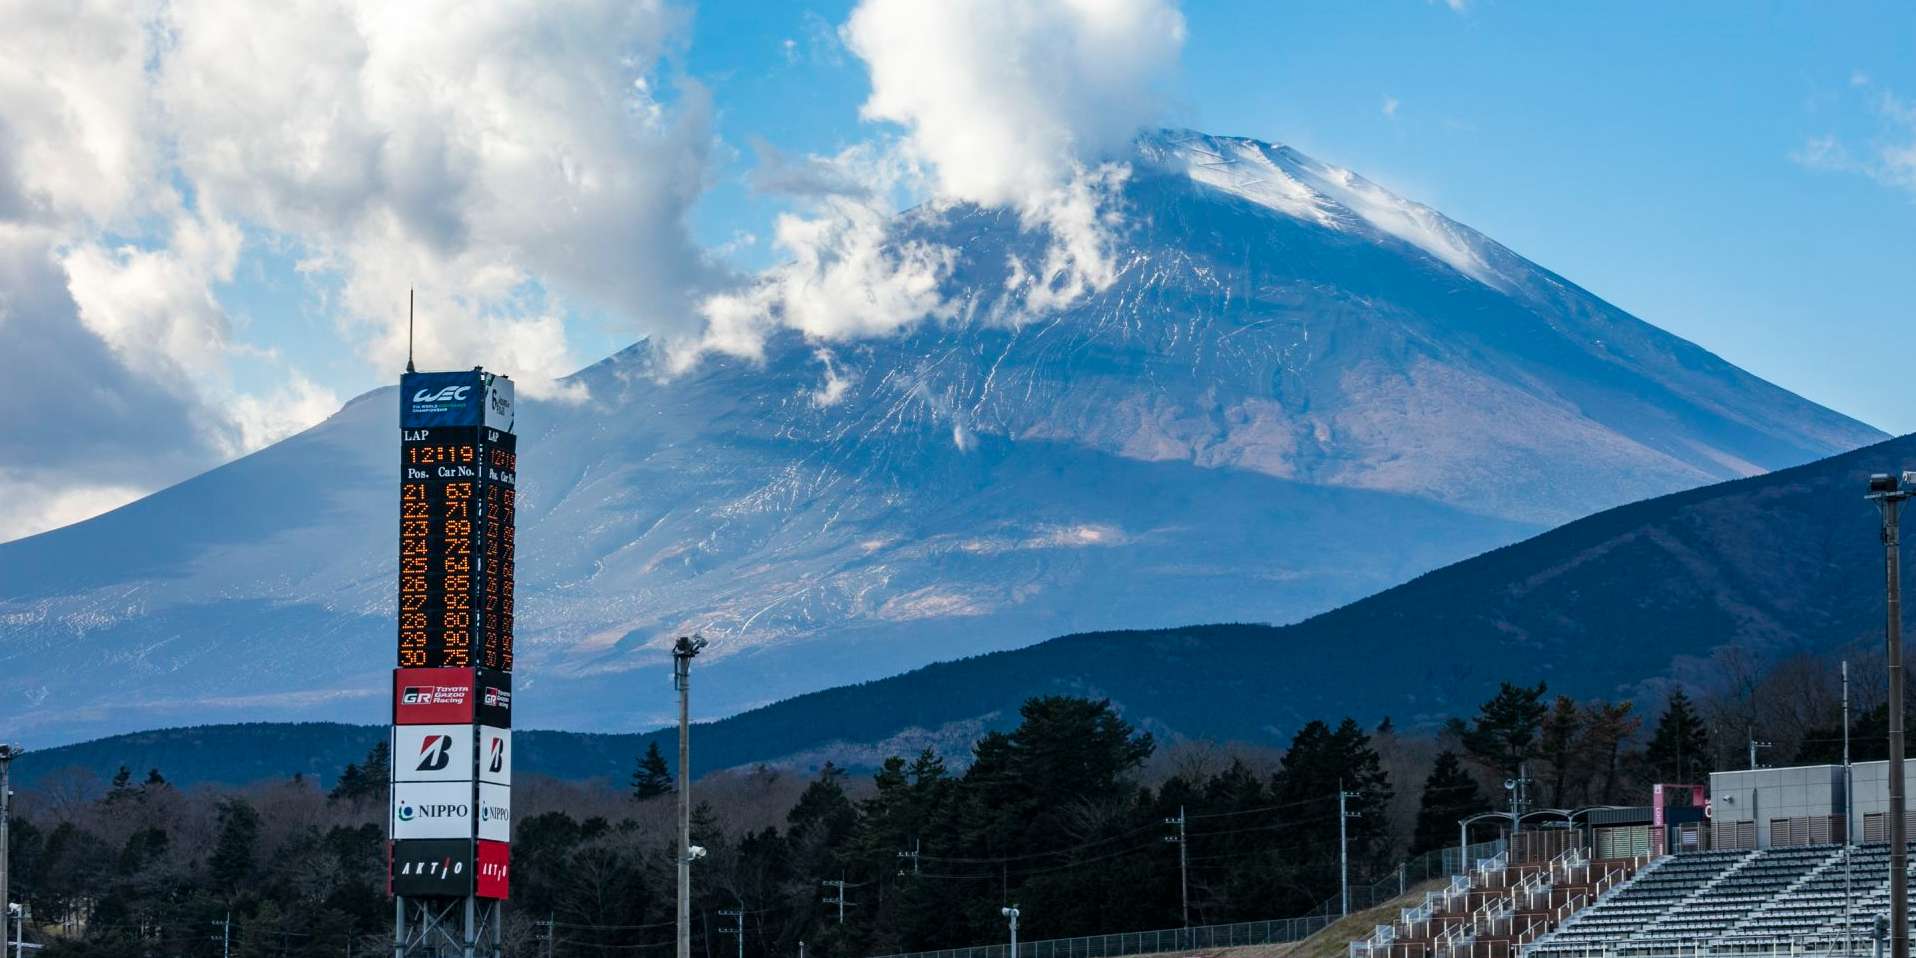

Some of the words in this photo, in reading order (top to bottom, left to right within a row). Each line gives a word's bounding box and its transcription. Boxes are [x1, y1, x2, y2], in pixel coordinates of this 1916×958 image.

[413, 386, 471, 402] WEC
[404, 430, 429, 441] LAP
[488, 430, 499, 442] LAP
[409, 446, 474, 464] 12:19
[408, 468, 429, 479] Pos.
[438, 466, 456, 477] Car
[458, 466, 475, 476] No.
[403, 484, 425, 500] 21
[446, 483, 471, 499] 63
[403, 503, 429, 518] 22
[446, 501, 467, 517] 71
[403, 521, 429, 536] 23
[445, 520, 471, 536] 89
[403, 539, 428, 555] 24
[445, 539, 470, 554] 72
[402, 558, 427, 573] 25
[444, 557, 470, 572] 64
[402, 576, 427, 592] 26
[444, 575, 470, 590] 85
[402, 594, 427, 610] 27
[444, 594, 469, 609] 92
[402, 613, 427, 629] 28
[444, 612, 469, 627] 80
[401, 632, 427, 647] 29
[444, 631, 469, 646] 90
[401, 650, 426, 665] 30
[443, 650, 469, 665] 75
[404, 693, 432, 704] GR
[484, 694, 497, 706] GR
[419, 804, 468, 817] NIPPO
[490, 807, 509, 821] NIPPO
